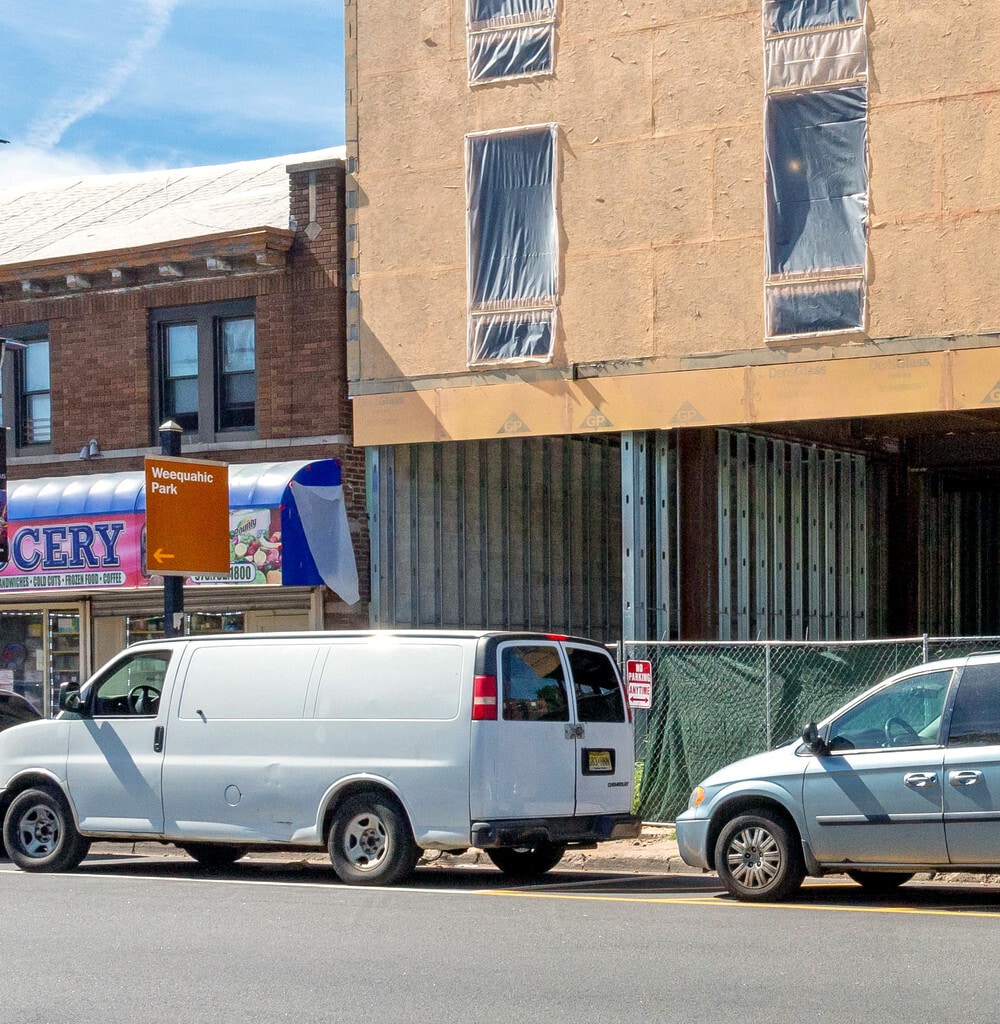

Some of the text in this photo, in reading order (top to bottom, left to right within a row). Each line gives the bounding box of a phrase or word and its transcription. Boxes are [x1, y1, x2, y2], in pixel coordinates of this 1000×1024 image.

[586, 416, 606, 427] GP
[677, 410, 697, 422] GP
[504, 421, 522, 433] GP
[151, 466, 214, 483] Weequahic
[151, 482, 178, 495] Park
[0, 522, 125, 573] CERY
[33, 576, 46, 587] COLD
[48, 575, 61, 586] CUTS
[65, 574, 84, 585] FROZEN
[85, 573, 98, 584] FOOD
[103, 573, 122, 584] COFFEE
[635, 663, 644, 673] NO
[628, 672, 651, 682] PARKING
[628, 685, 650, 695] ANYTIME
